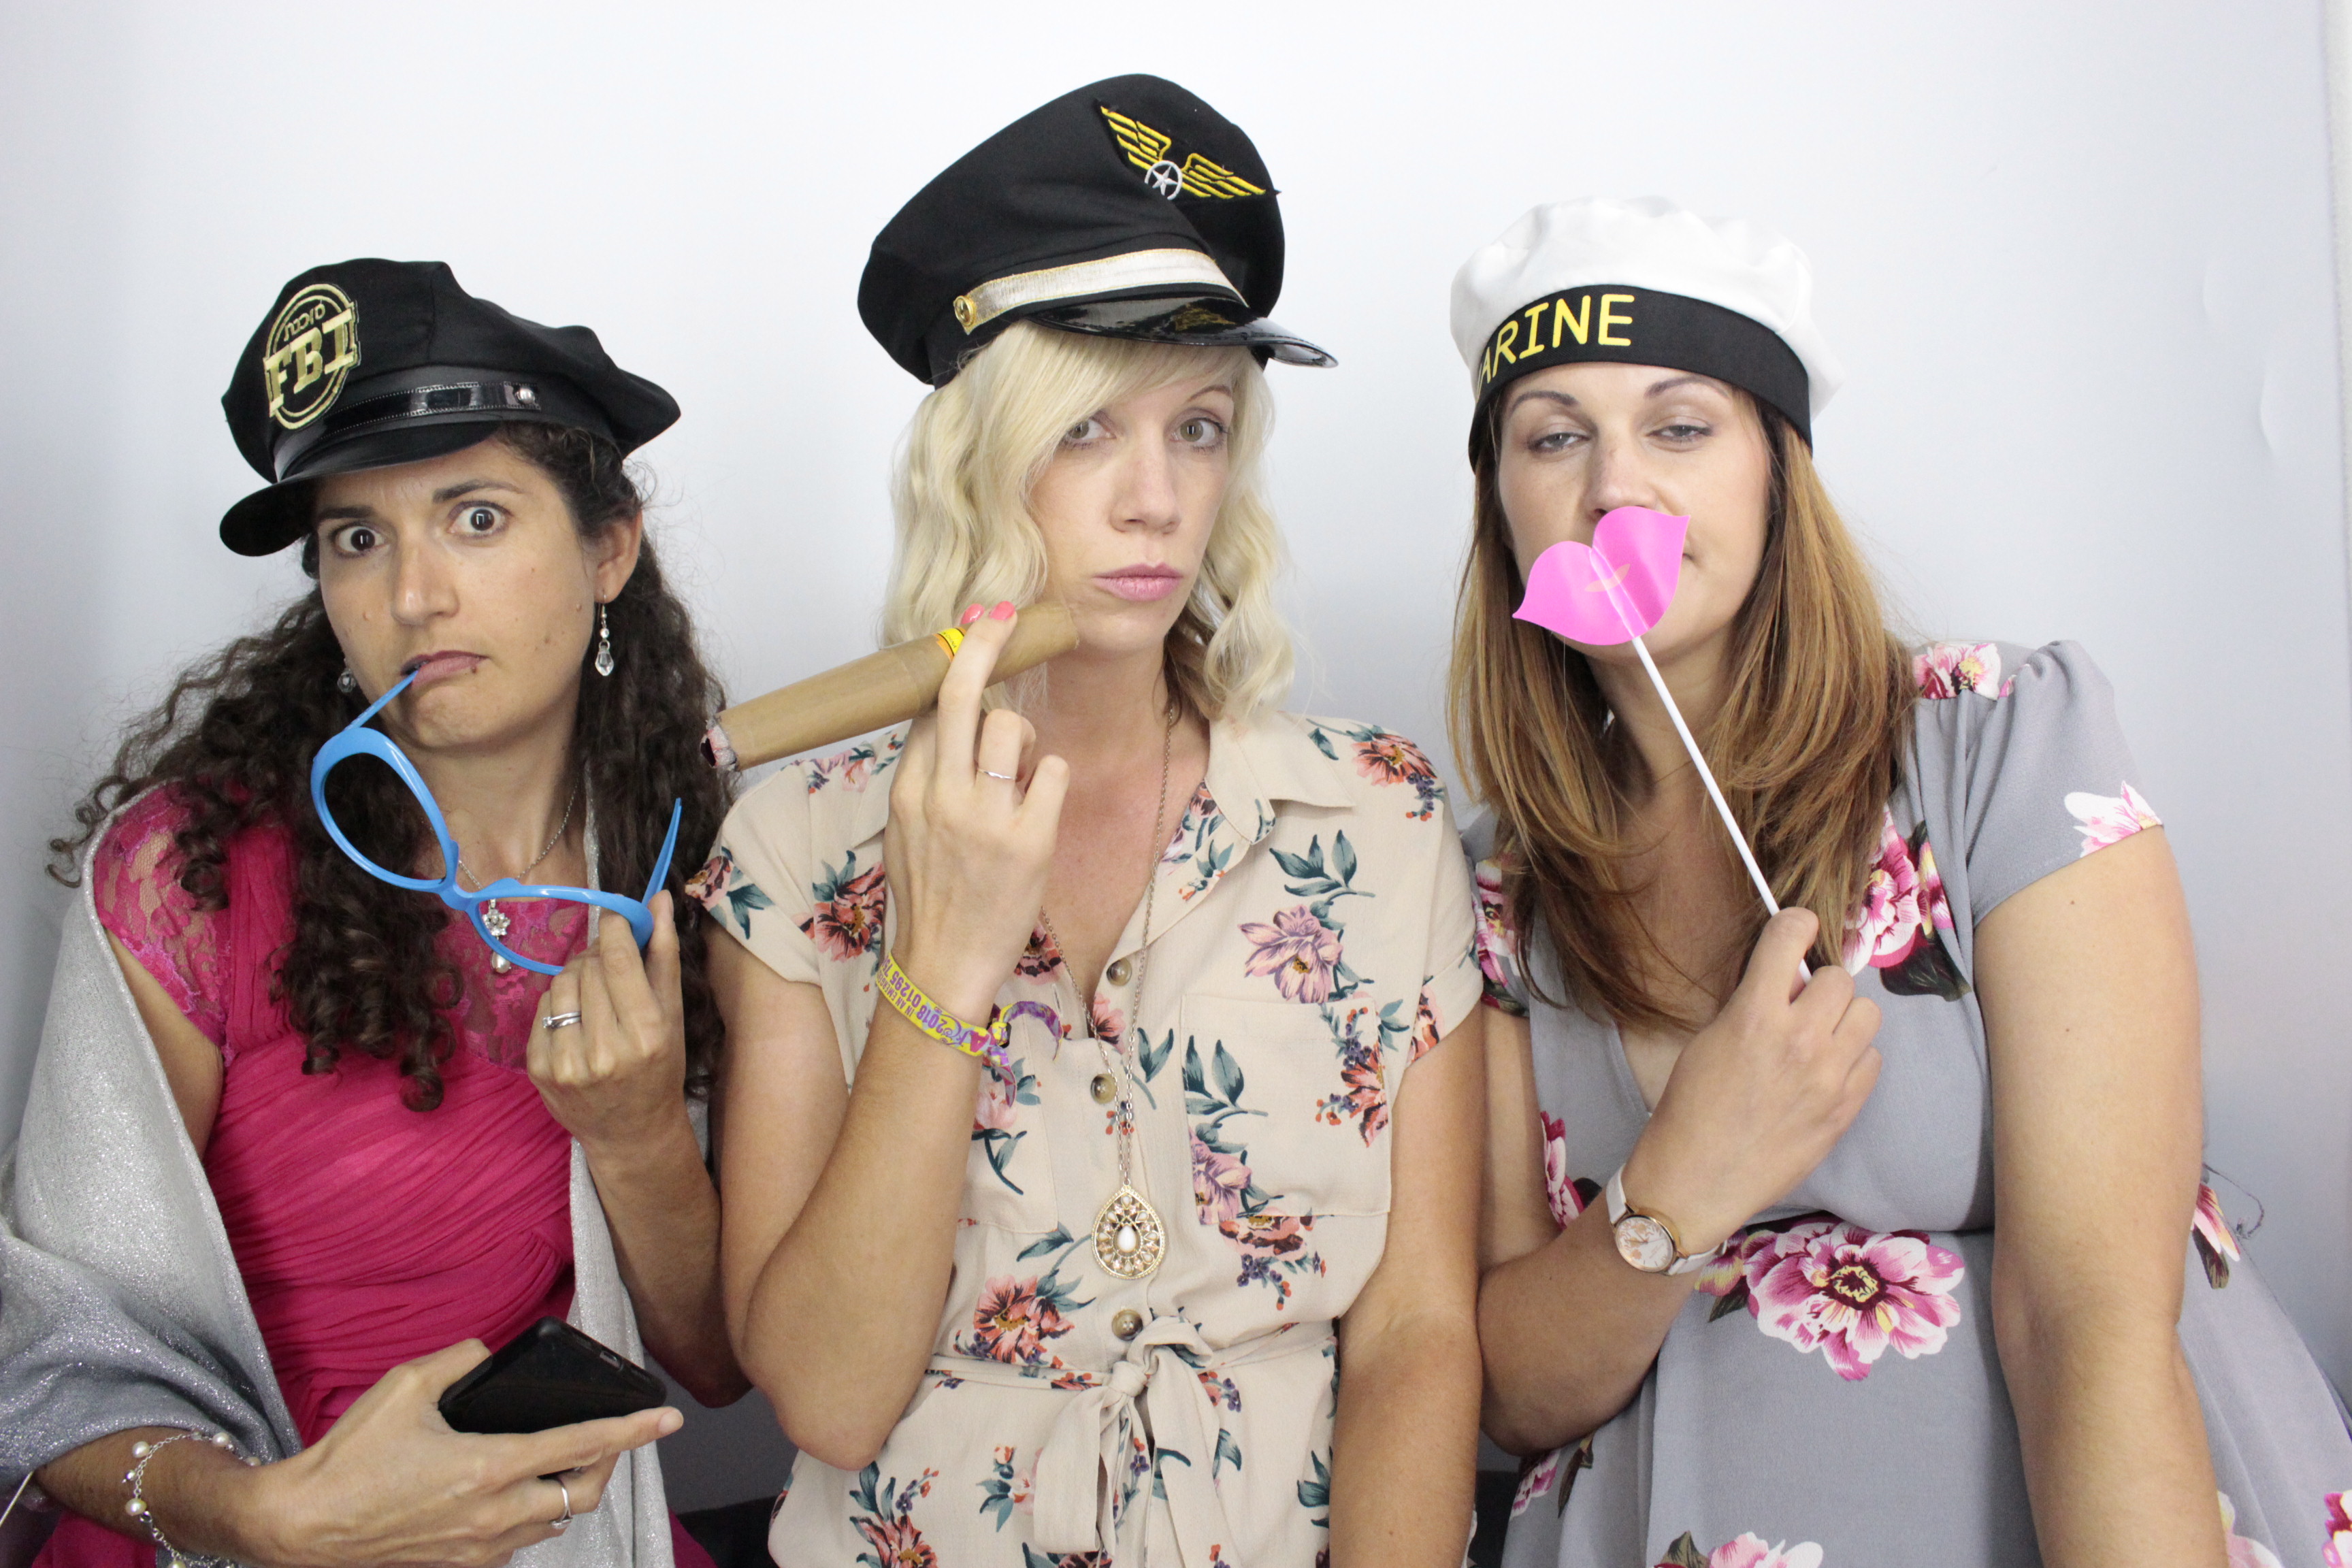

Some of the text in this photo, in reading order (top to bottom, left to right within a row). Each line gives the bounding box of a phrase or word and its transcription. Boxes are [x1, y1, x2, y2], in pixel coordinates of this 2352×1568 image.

[263, 308, 355, 418] FBI
[1475, 293, 1635, 403] ARINE
[890, 970, 922, 1008] 01295
[895, 996, 906, 1009] AN
[904, 1005, 915, 1017] IN
[917, 1004, 947, 1034] 2018
